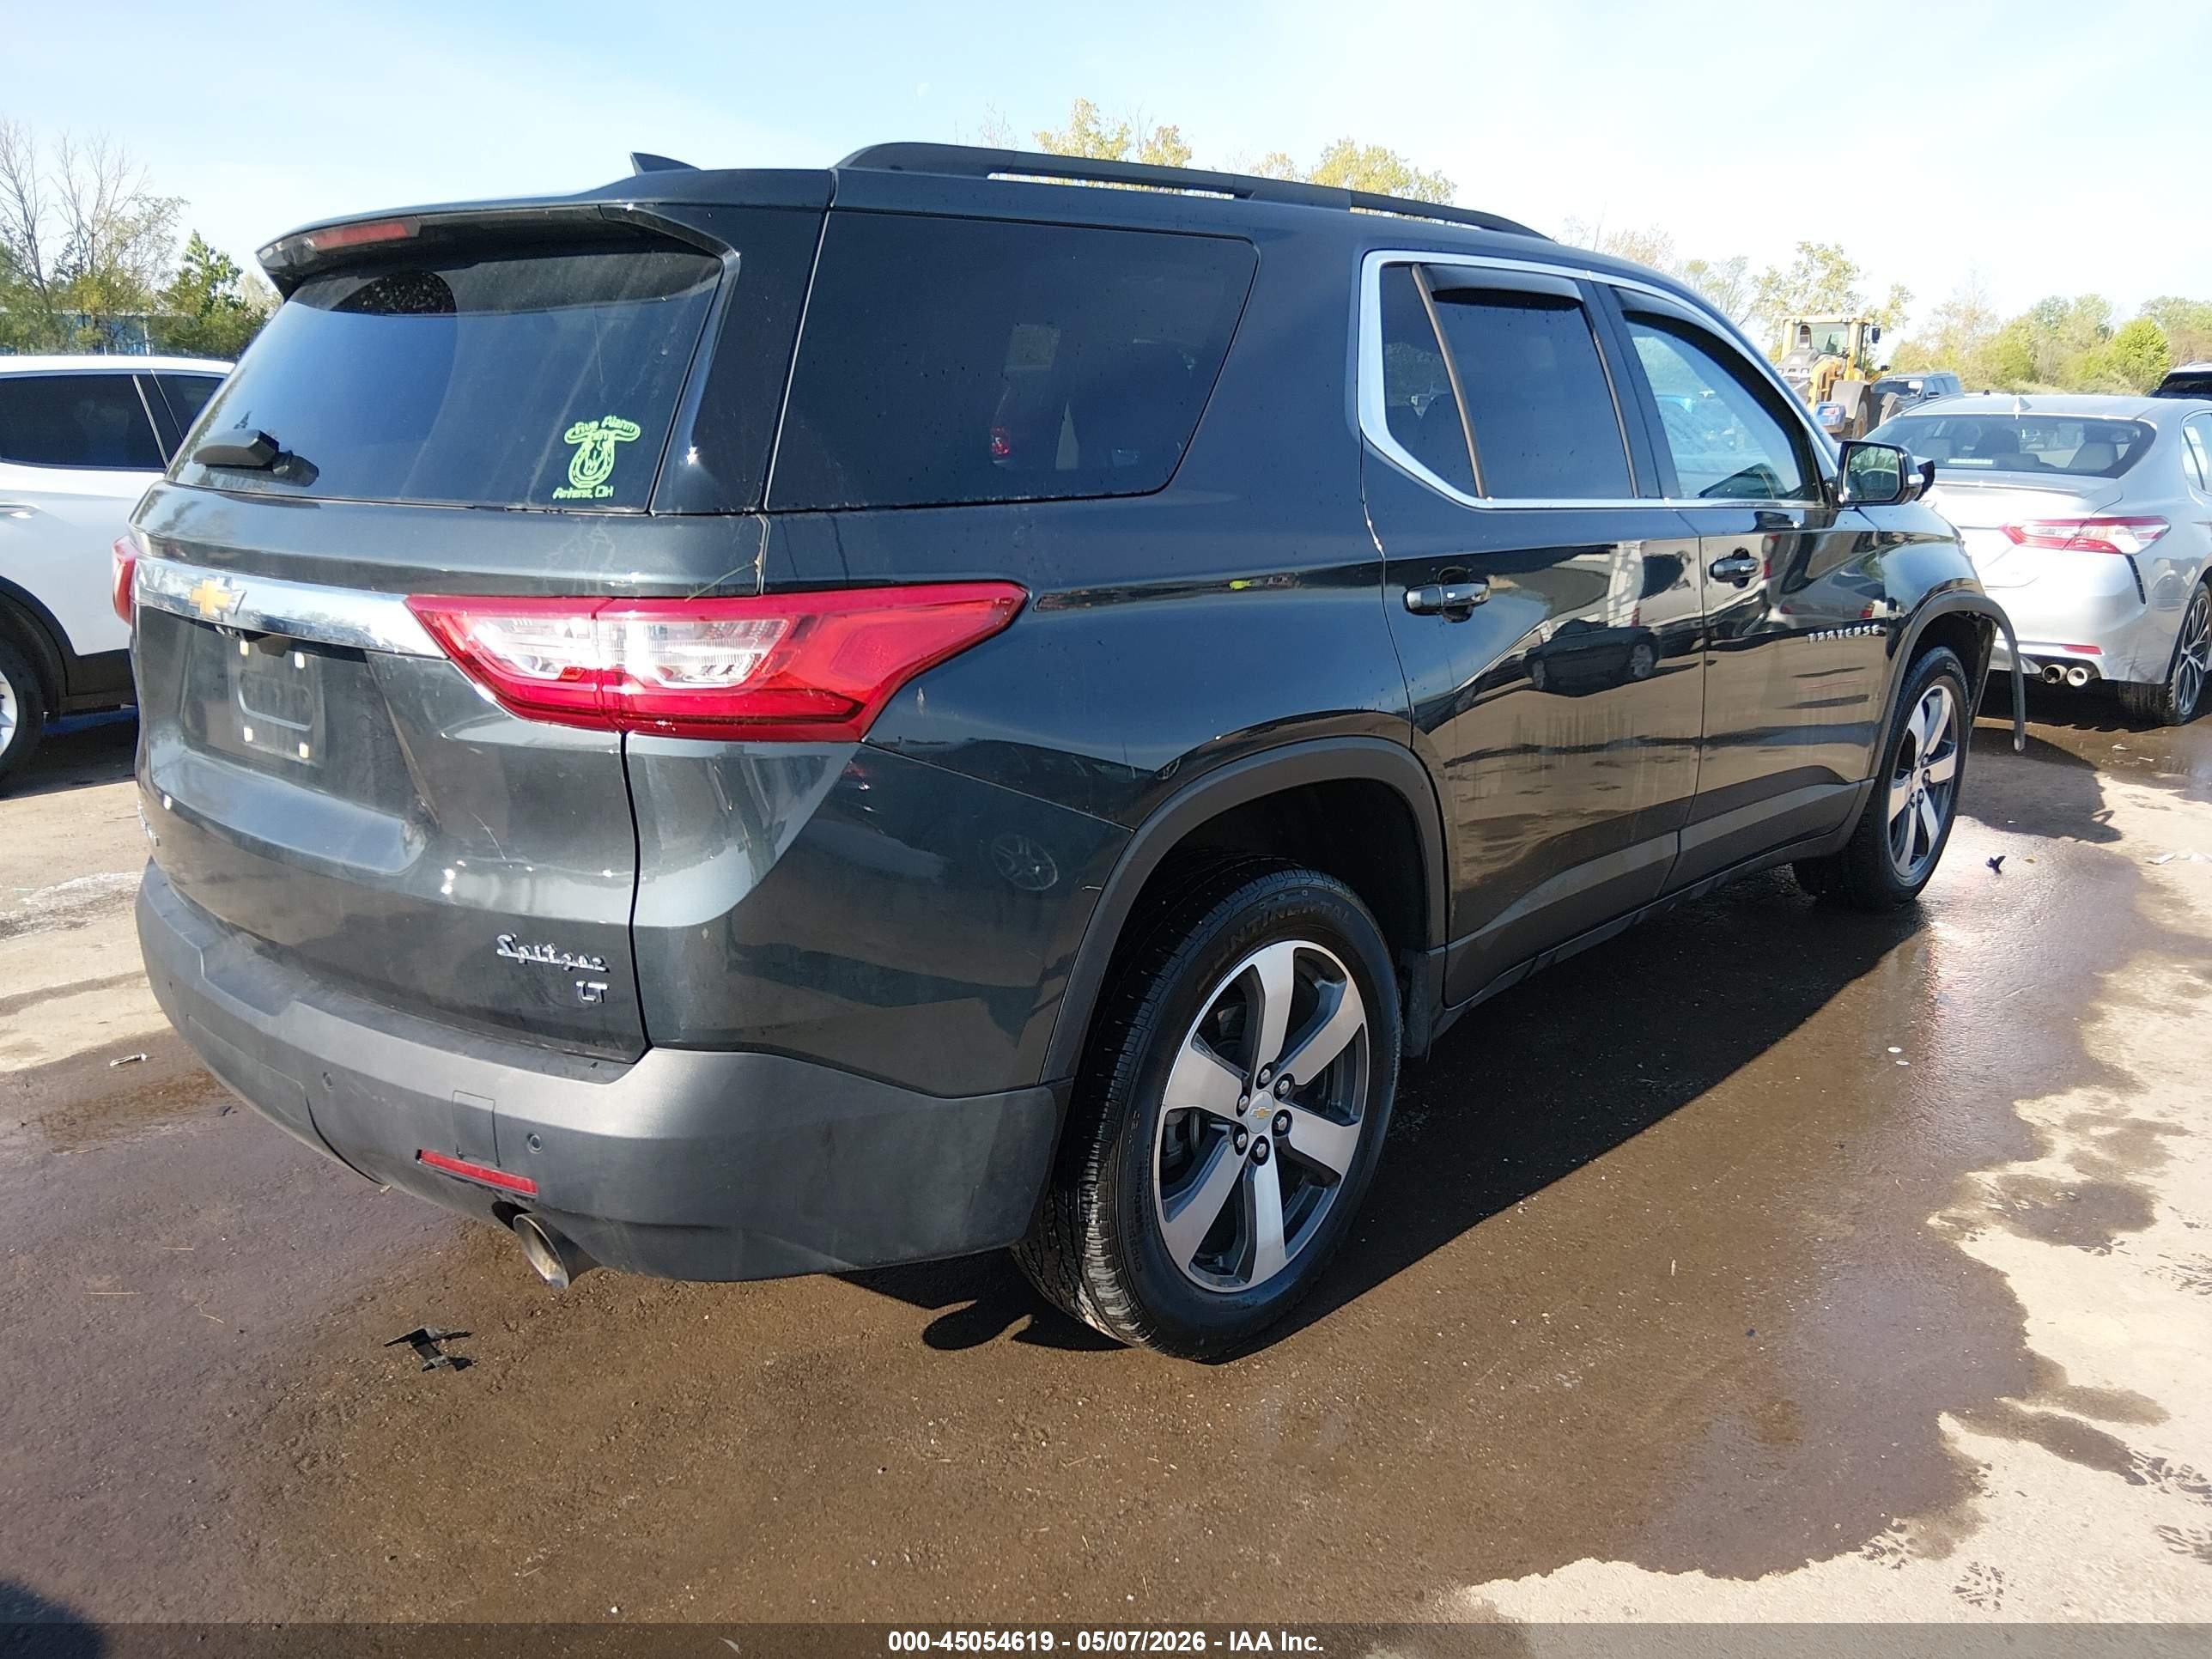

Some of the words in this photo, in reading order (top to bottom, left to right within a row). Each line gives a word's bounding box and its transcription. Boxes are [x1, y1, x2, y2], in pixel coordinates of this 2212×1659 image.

[594, 484, 614, 498] OH
[1807, 623, 1881, 645] TRAVERSE
[575, 980, 608, 1004] LT
